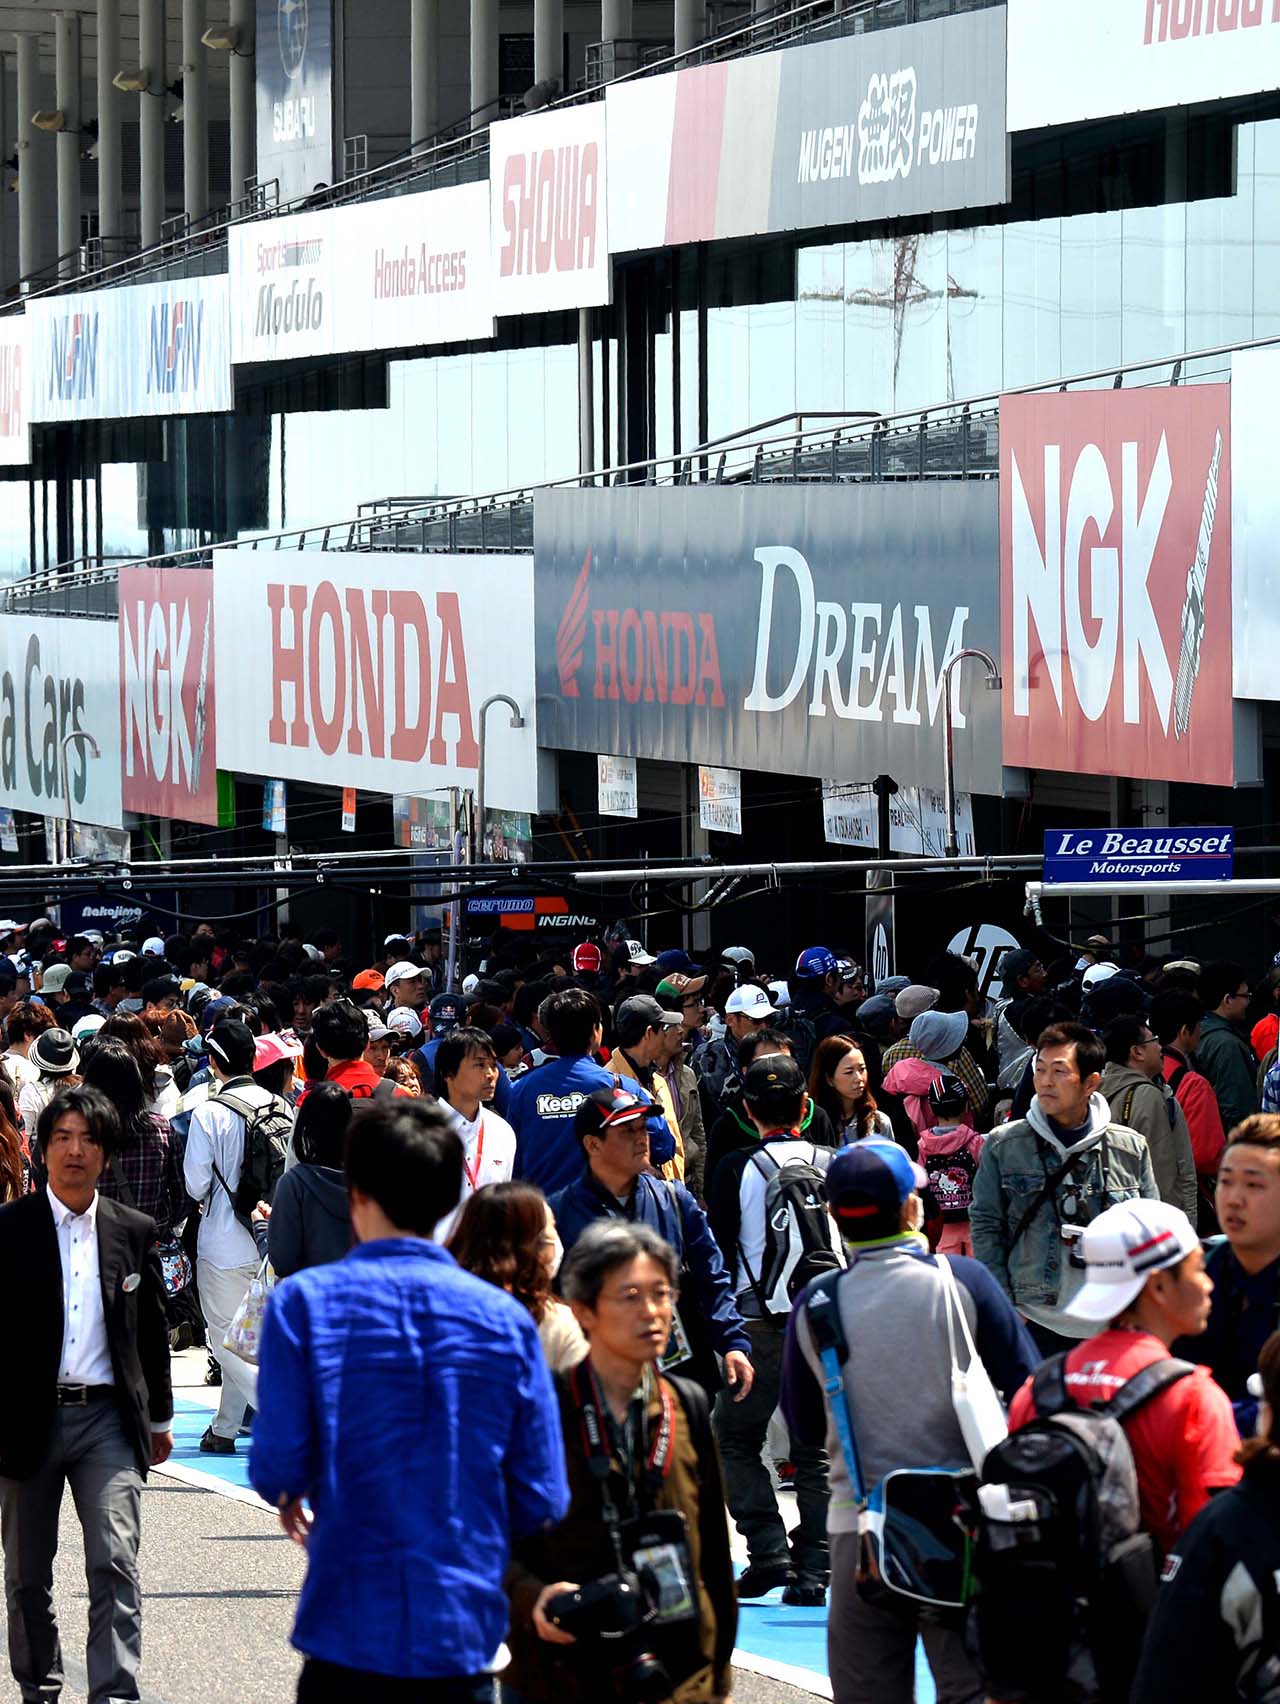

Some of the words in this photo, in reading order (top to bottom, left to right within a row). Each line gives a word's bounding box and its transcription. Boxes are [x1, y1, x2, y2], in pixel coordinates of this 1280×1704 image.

[273, 96, 315, 143] SUBARU
[798, 124, 855, 184] MUGEN
[917, 104, 979, 167] POWER
[500, 141, 598, 278] SHOWA
[374, 244, 416, 298] Honda
[418, 242, 467, 295] Access
[255, 278, 323, 337] Modulo
[1011, 428, 1174, 738] NGK
[267, 581, 480, 769] HONDA
[593, 608, 725, 708] HONDA
[24, 633, 87, 805] Cars
[123, 596, 195, 793] NGK
[1056, 833, 1094, 856] Le
[1099, 833, 1232, 855] Beausset
[1089, 861, 1182, 877] Motorsports
[82, 906, 143, 919] Nakajima
[538, 915, 597, 927] INGING
